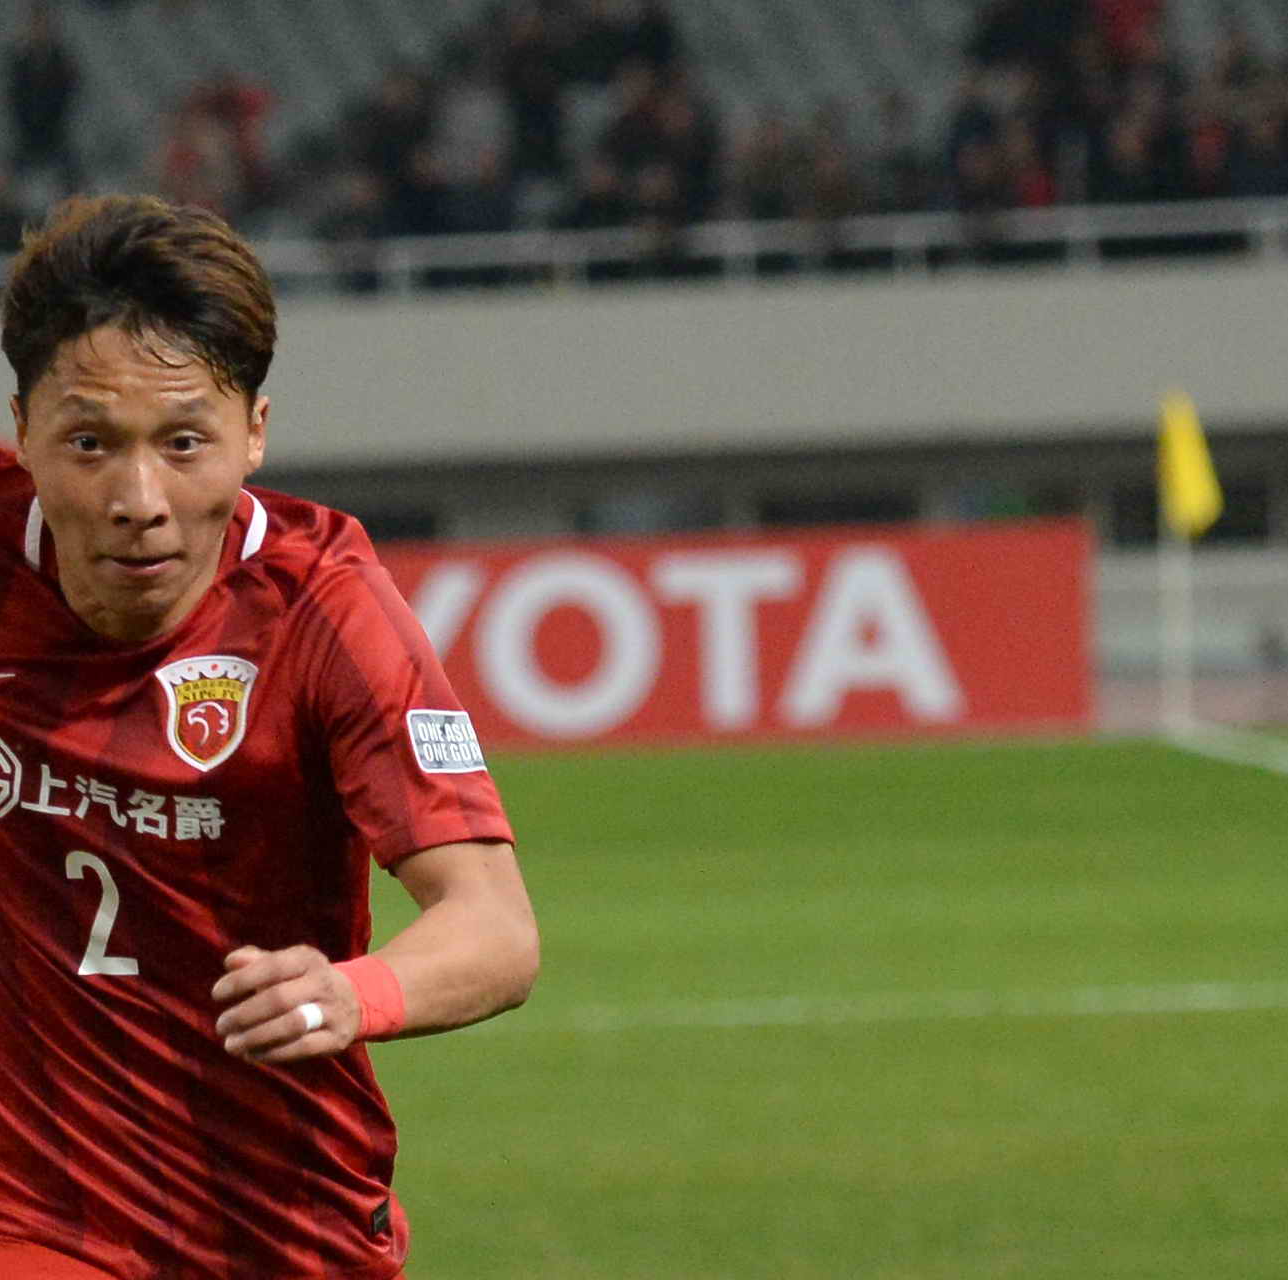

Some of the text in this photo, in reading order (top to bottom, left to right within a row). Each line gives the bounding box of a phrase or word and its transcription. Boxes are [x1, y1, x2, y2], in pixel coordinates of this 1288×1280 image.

[416, 721, 444, 742] ONE
[422, 743, 449, 762] ONE
[21, 763, 225, 840] 上汽名爵
[65, 851, 139, 976] 2
